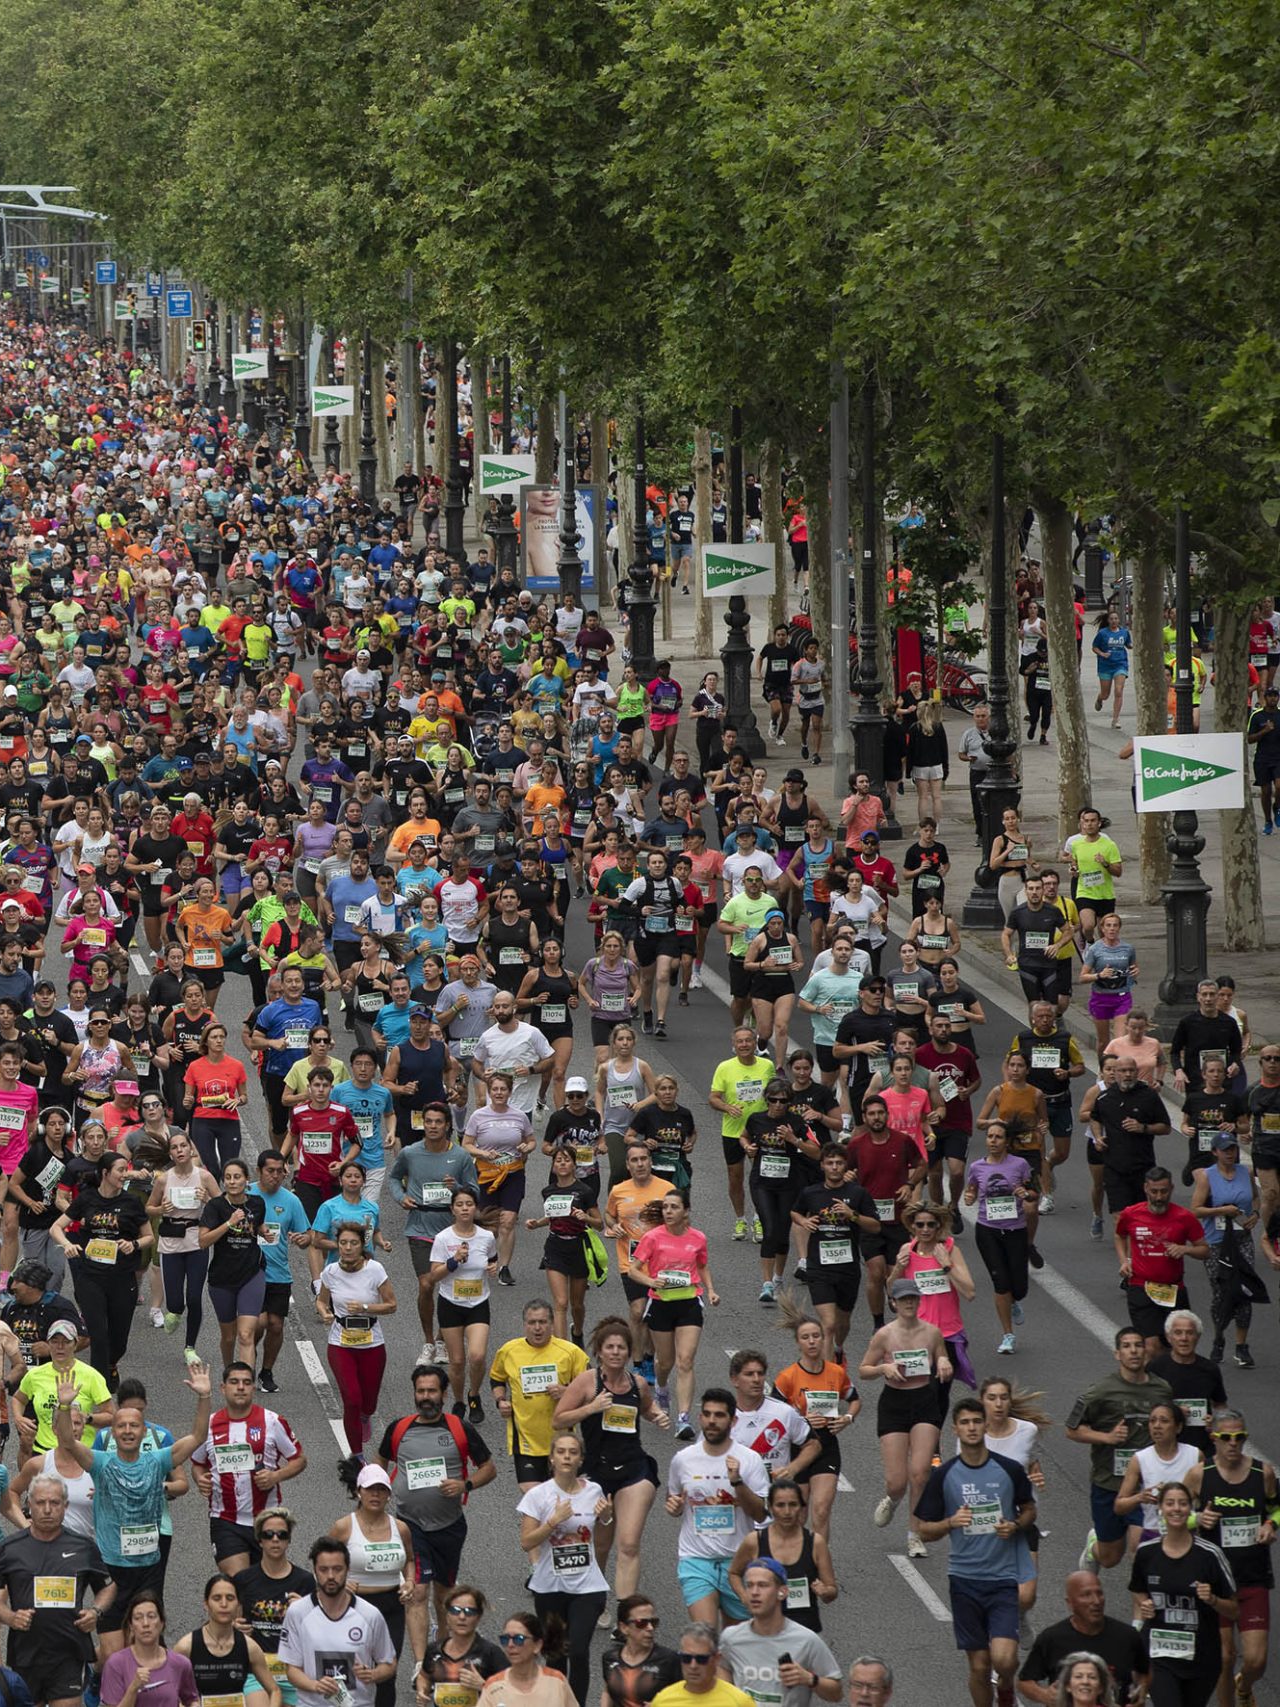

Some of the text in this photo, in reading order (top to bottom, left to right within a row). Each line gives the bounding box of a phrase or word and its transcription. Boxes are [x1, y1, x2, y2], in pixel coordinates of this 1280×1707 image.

[1144, 767, 1154, 779] El
[1155, 766, 1179, 778] Corte
[739, 1088, 761, 1096] 27490
[0, 1114, 21, 1124] 13572
[305, 1140, 327, 1148] 12315
[42, 1164, 60, 1183] 28374
[990, 1205, 1013, 1213] 13096
[921, 1279, 945, 1288] 27582
[527, 1375, 553, 1384] 27318
[221, 1454, 249, 1464] 26657
[414, 1470, 441, 1480] 26655
[963, 1484, 980, 1494] EL
[701, 1517, 728, 1526] 2640
[127, 1536, 154, 1546] 29874
[371, 1553, 400, 1563] 20271
[559, 1555, 585, 1566] 3470
[44, 1590, 67, 1598] 7615
